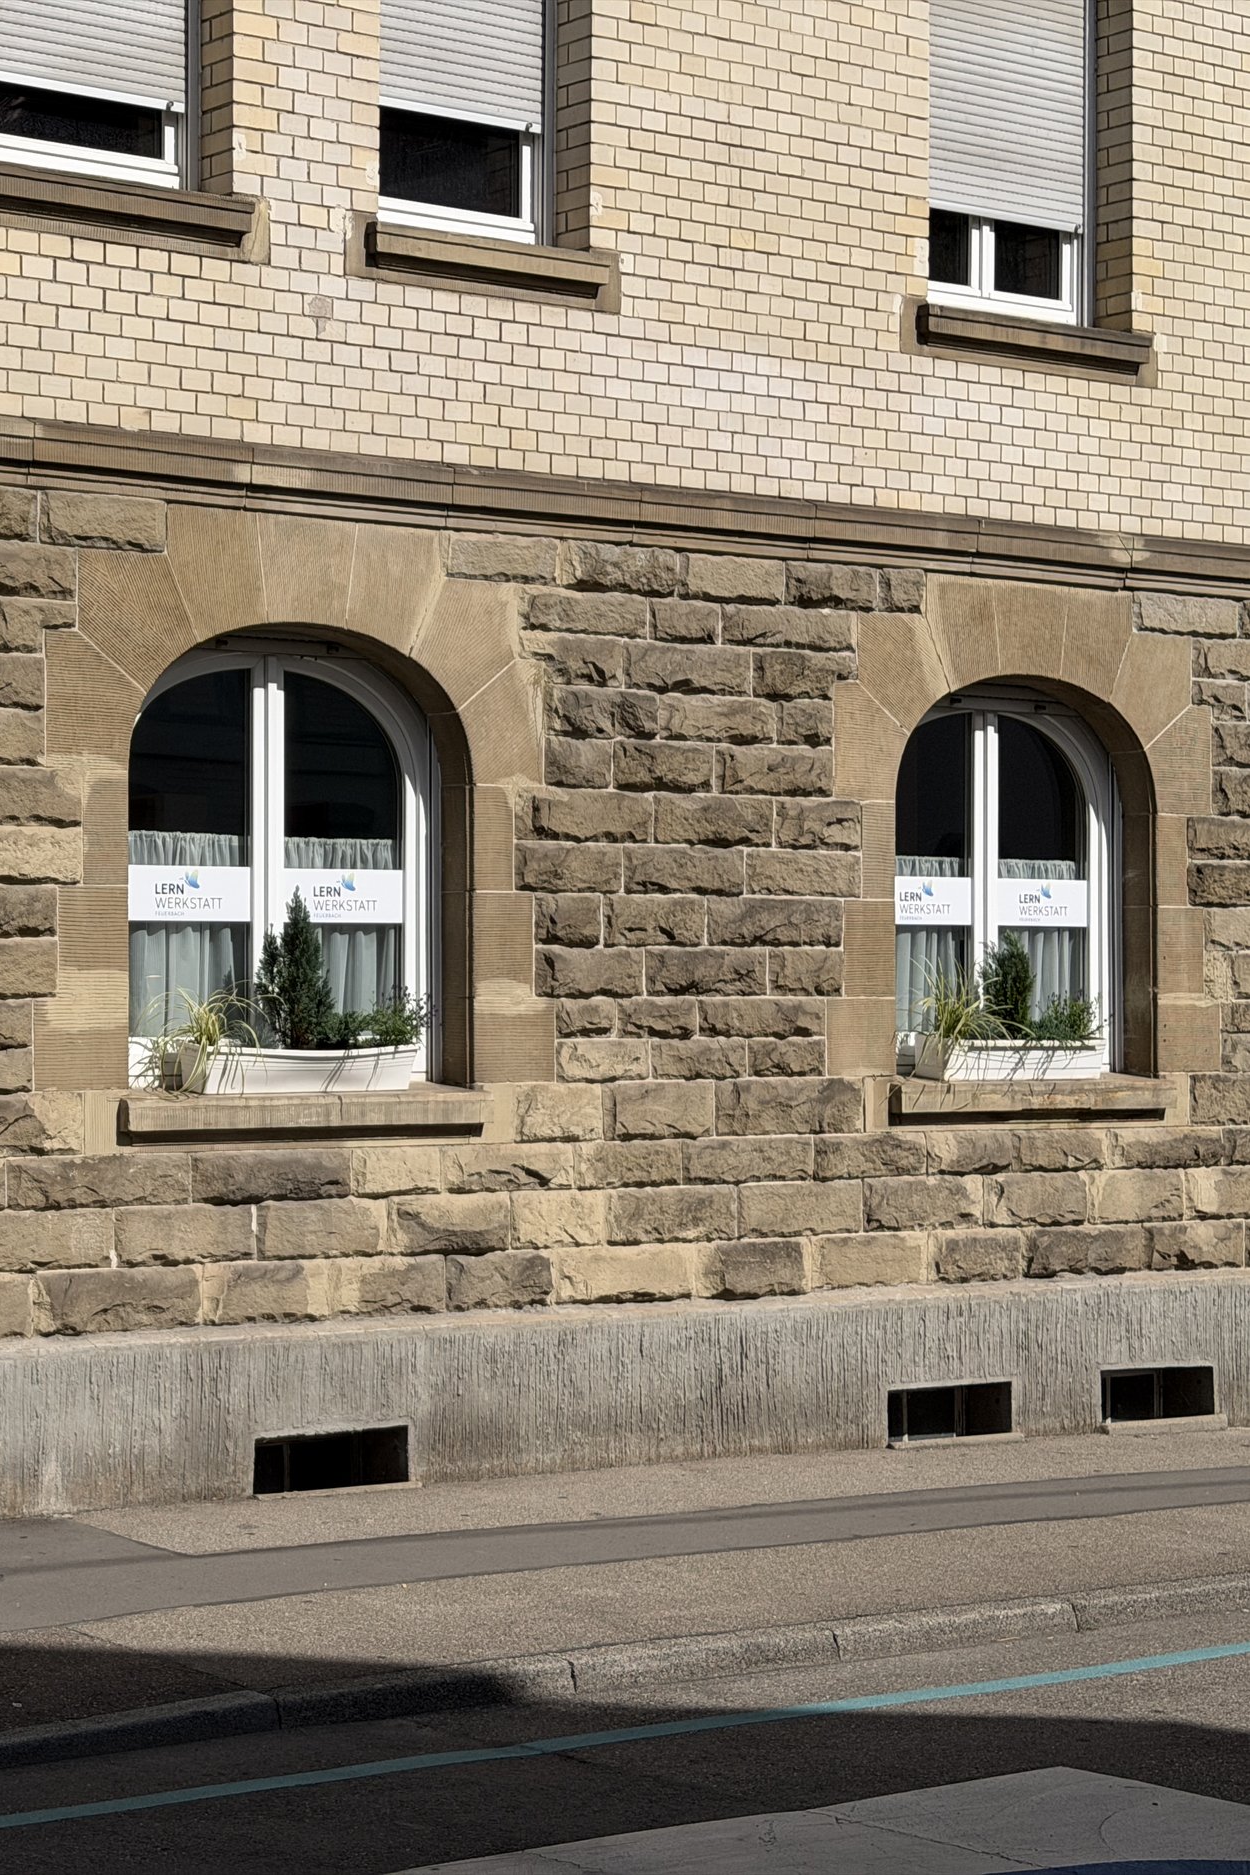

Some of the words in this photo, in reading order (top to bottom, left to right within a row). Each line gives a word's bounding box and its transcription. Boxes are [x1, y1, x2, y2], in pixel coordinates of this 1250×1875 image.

[155, 883, 184, 895] LERN
[313, 886, 341, 897] LERN
[899, 892, 922, 902] LERN
[1019, 893, 1040, 904] LERN
[155, 897, 222, 909] WERKSTATT
[313, 900, 377, 912] WERKSTATT
[899, 904, 950, 915] WERKSTATT
[1019, 906, 1067, 916] WERKSTATT
